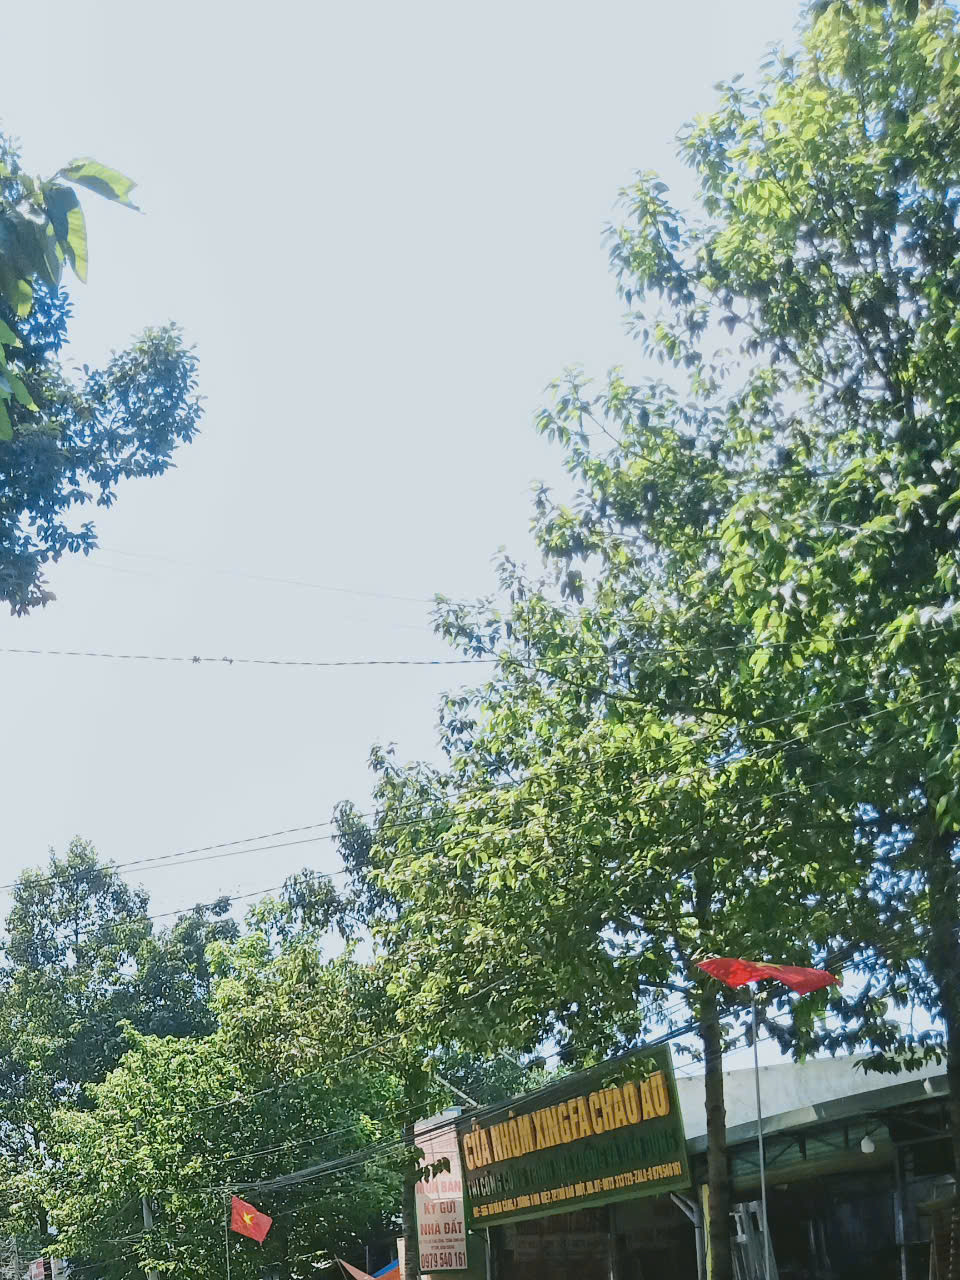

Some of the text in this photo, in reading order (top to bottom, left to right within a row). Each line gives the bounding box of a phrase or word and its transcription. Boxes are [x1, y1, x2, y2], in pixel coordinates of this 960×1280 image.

[531, 1096, 591, 1150] XINGFA
[444, 1217, 463, 1235] ĐẤT
[421, 1251, 467, 1269] 0979 540 161
